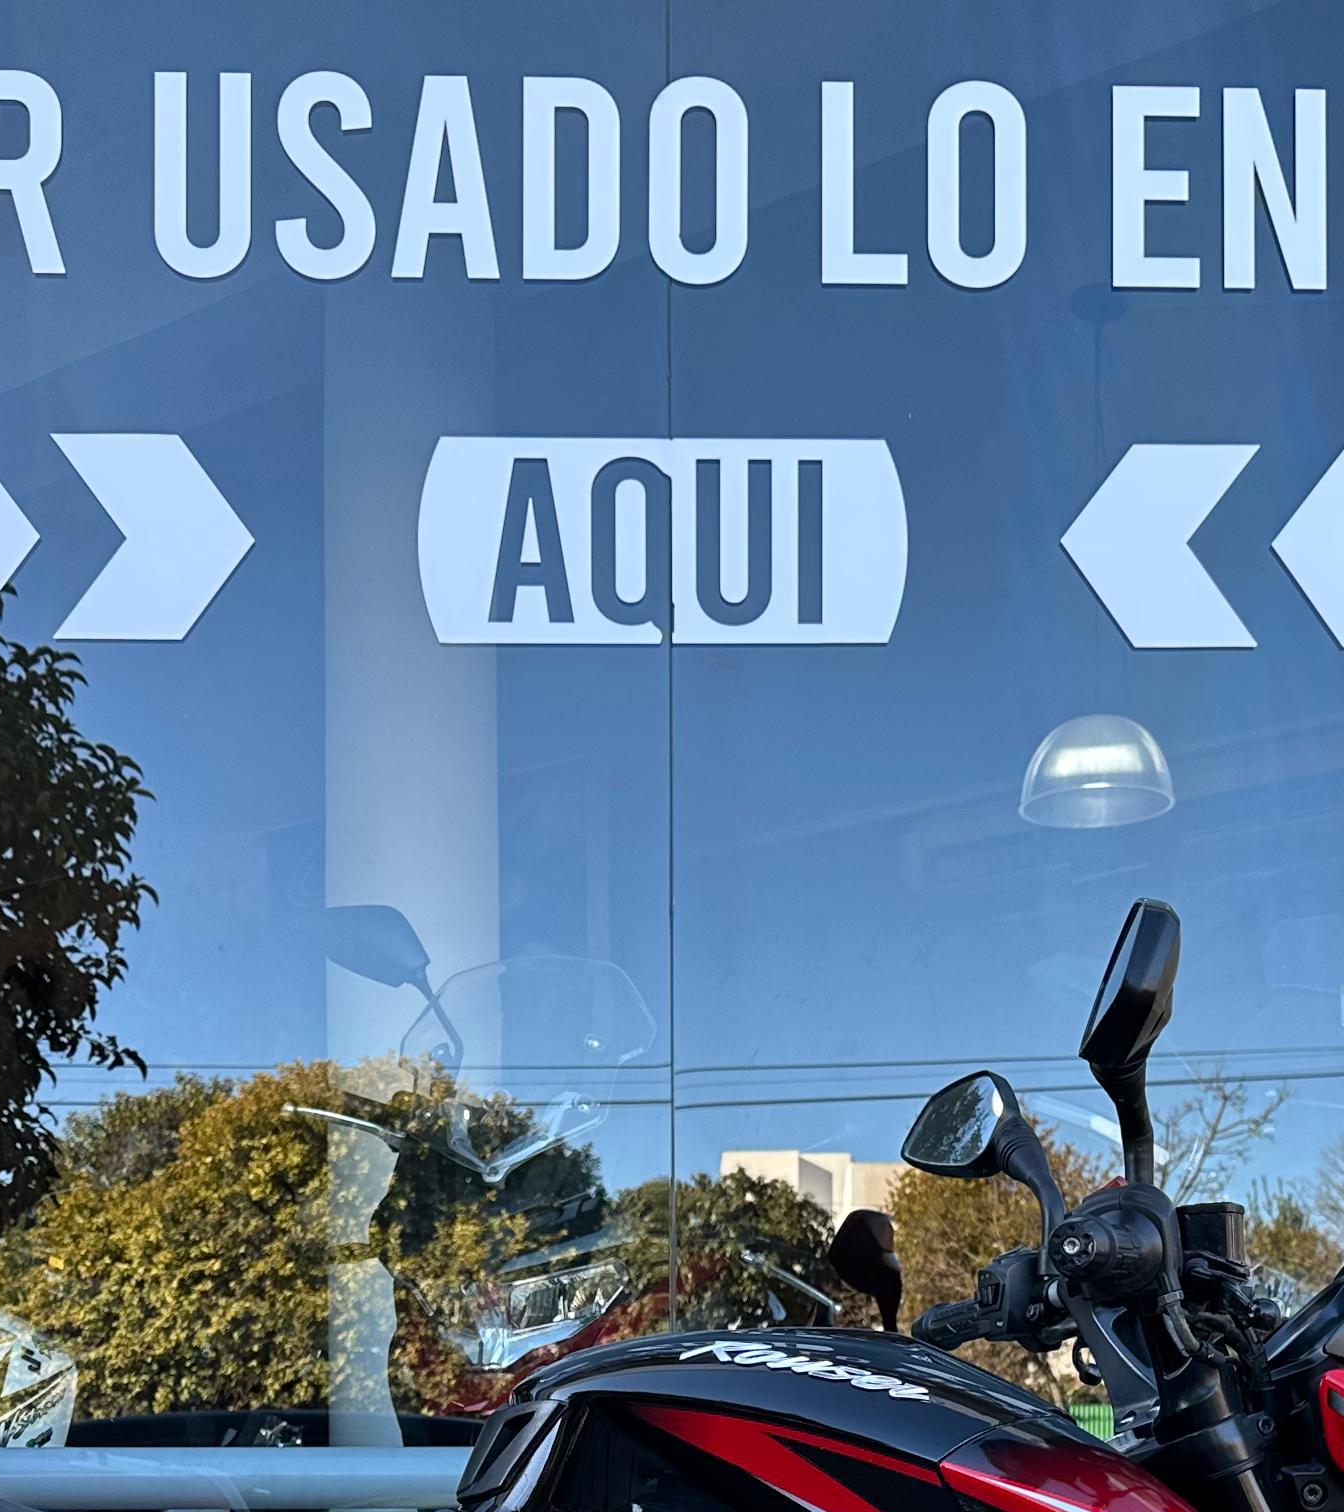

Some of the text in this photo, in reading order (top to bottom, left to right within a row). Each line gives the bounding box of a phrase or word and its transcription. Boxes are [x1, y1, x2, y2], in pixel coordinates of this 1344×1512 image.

[153, 70, 750, 286] USADO
[820, 80, 1028, 290] LO
[487, 456, 824, 632] AQUI
